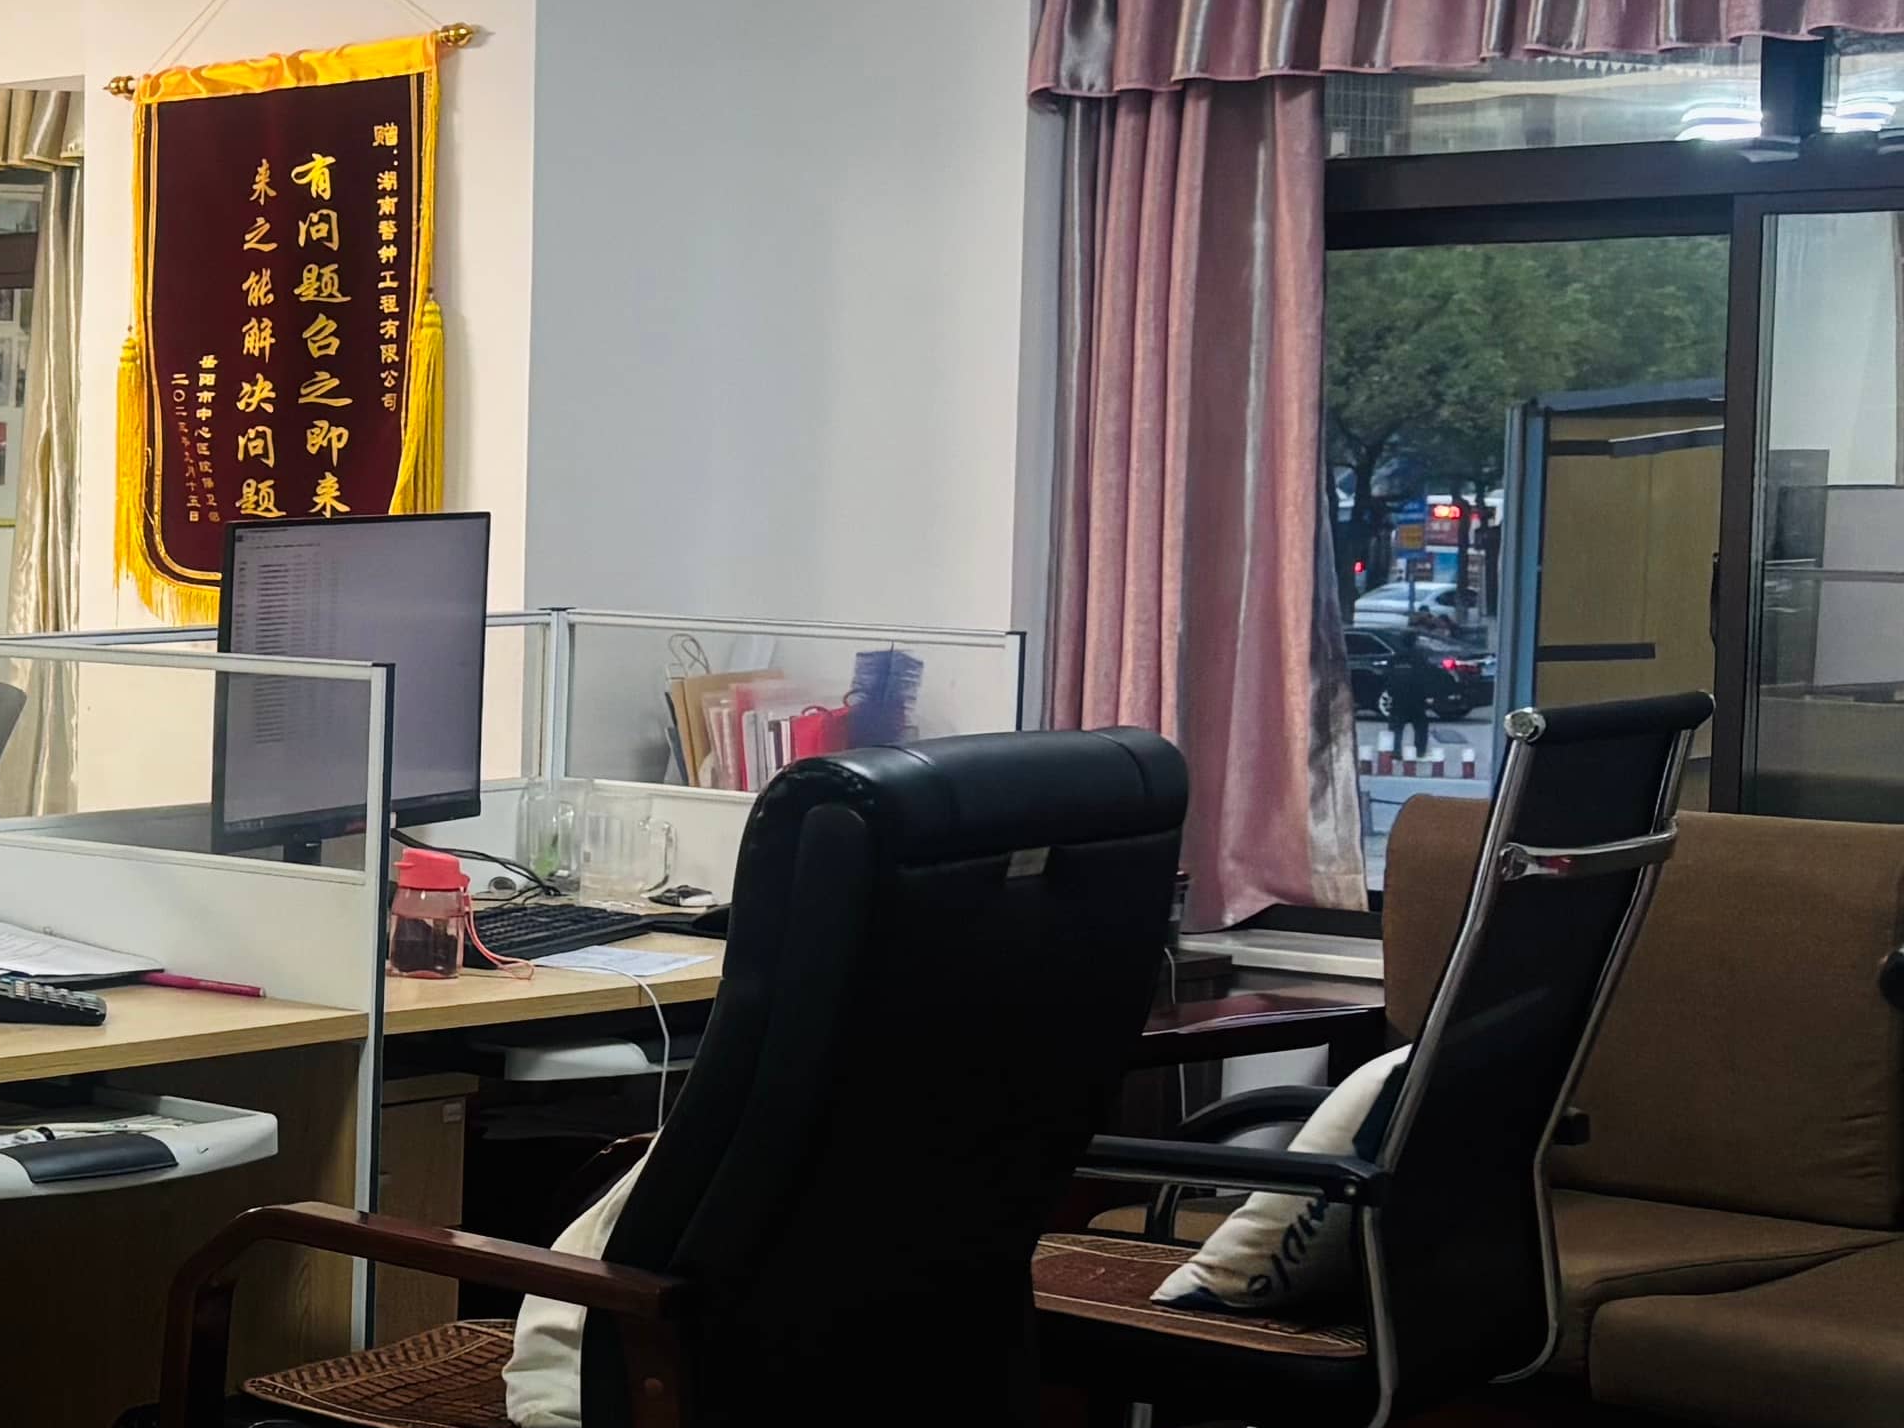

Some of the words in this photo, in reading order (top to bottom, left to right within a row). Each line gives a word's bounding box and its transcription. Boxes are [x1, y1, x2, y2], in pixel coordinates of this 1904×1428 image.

[235, 158, 284, 517] 来之能解决问题
[291, 153, 352, 516] 有问题召之即来
